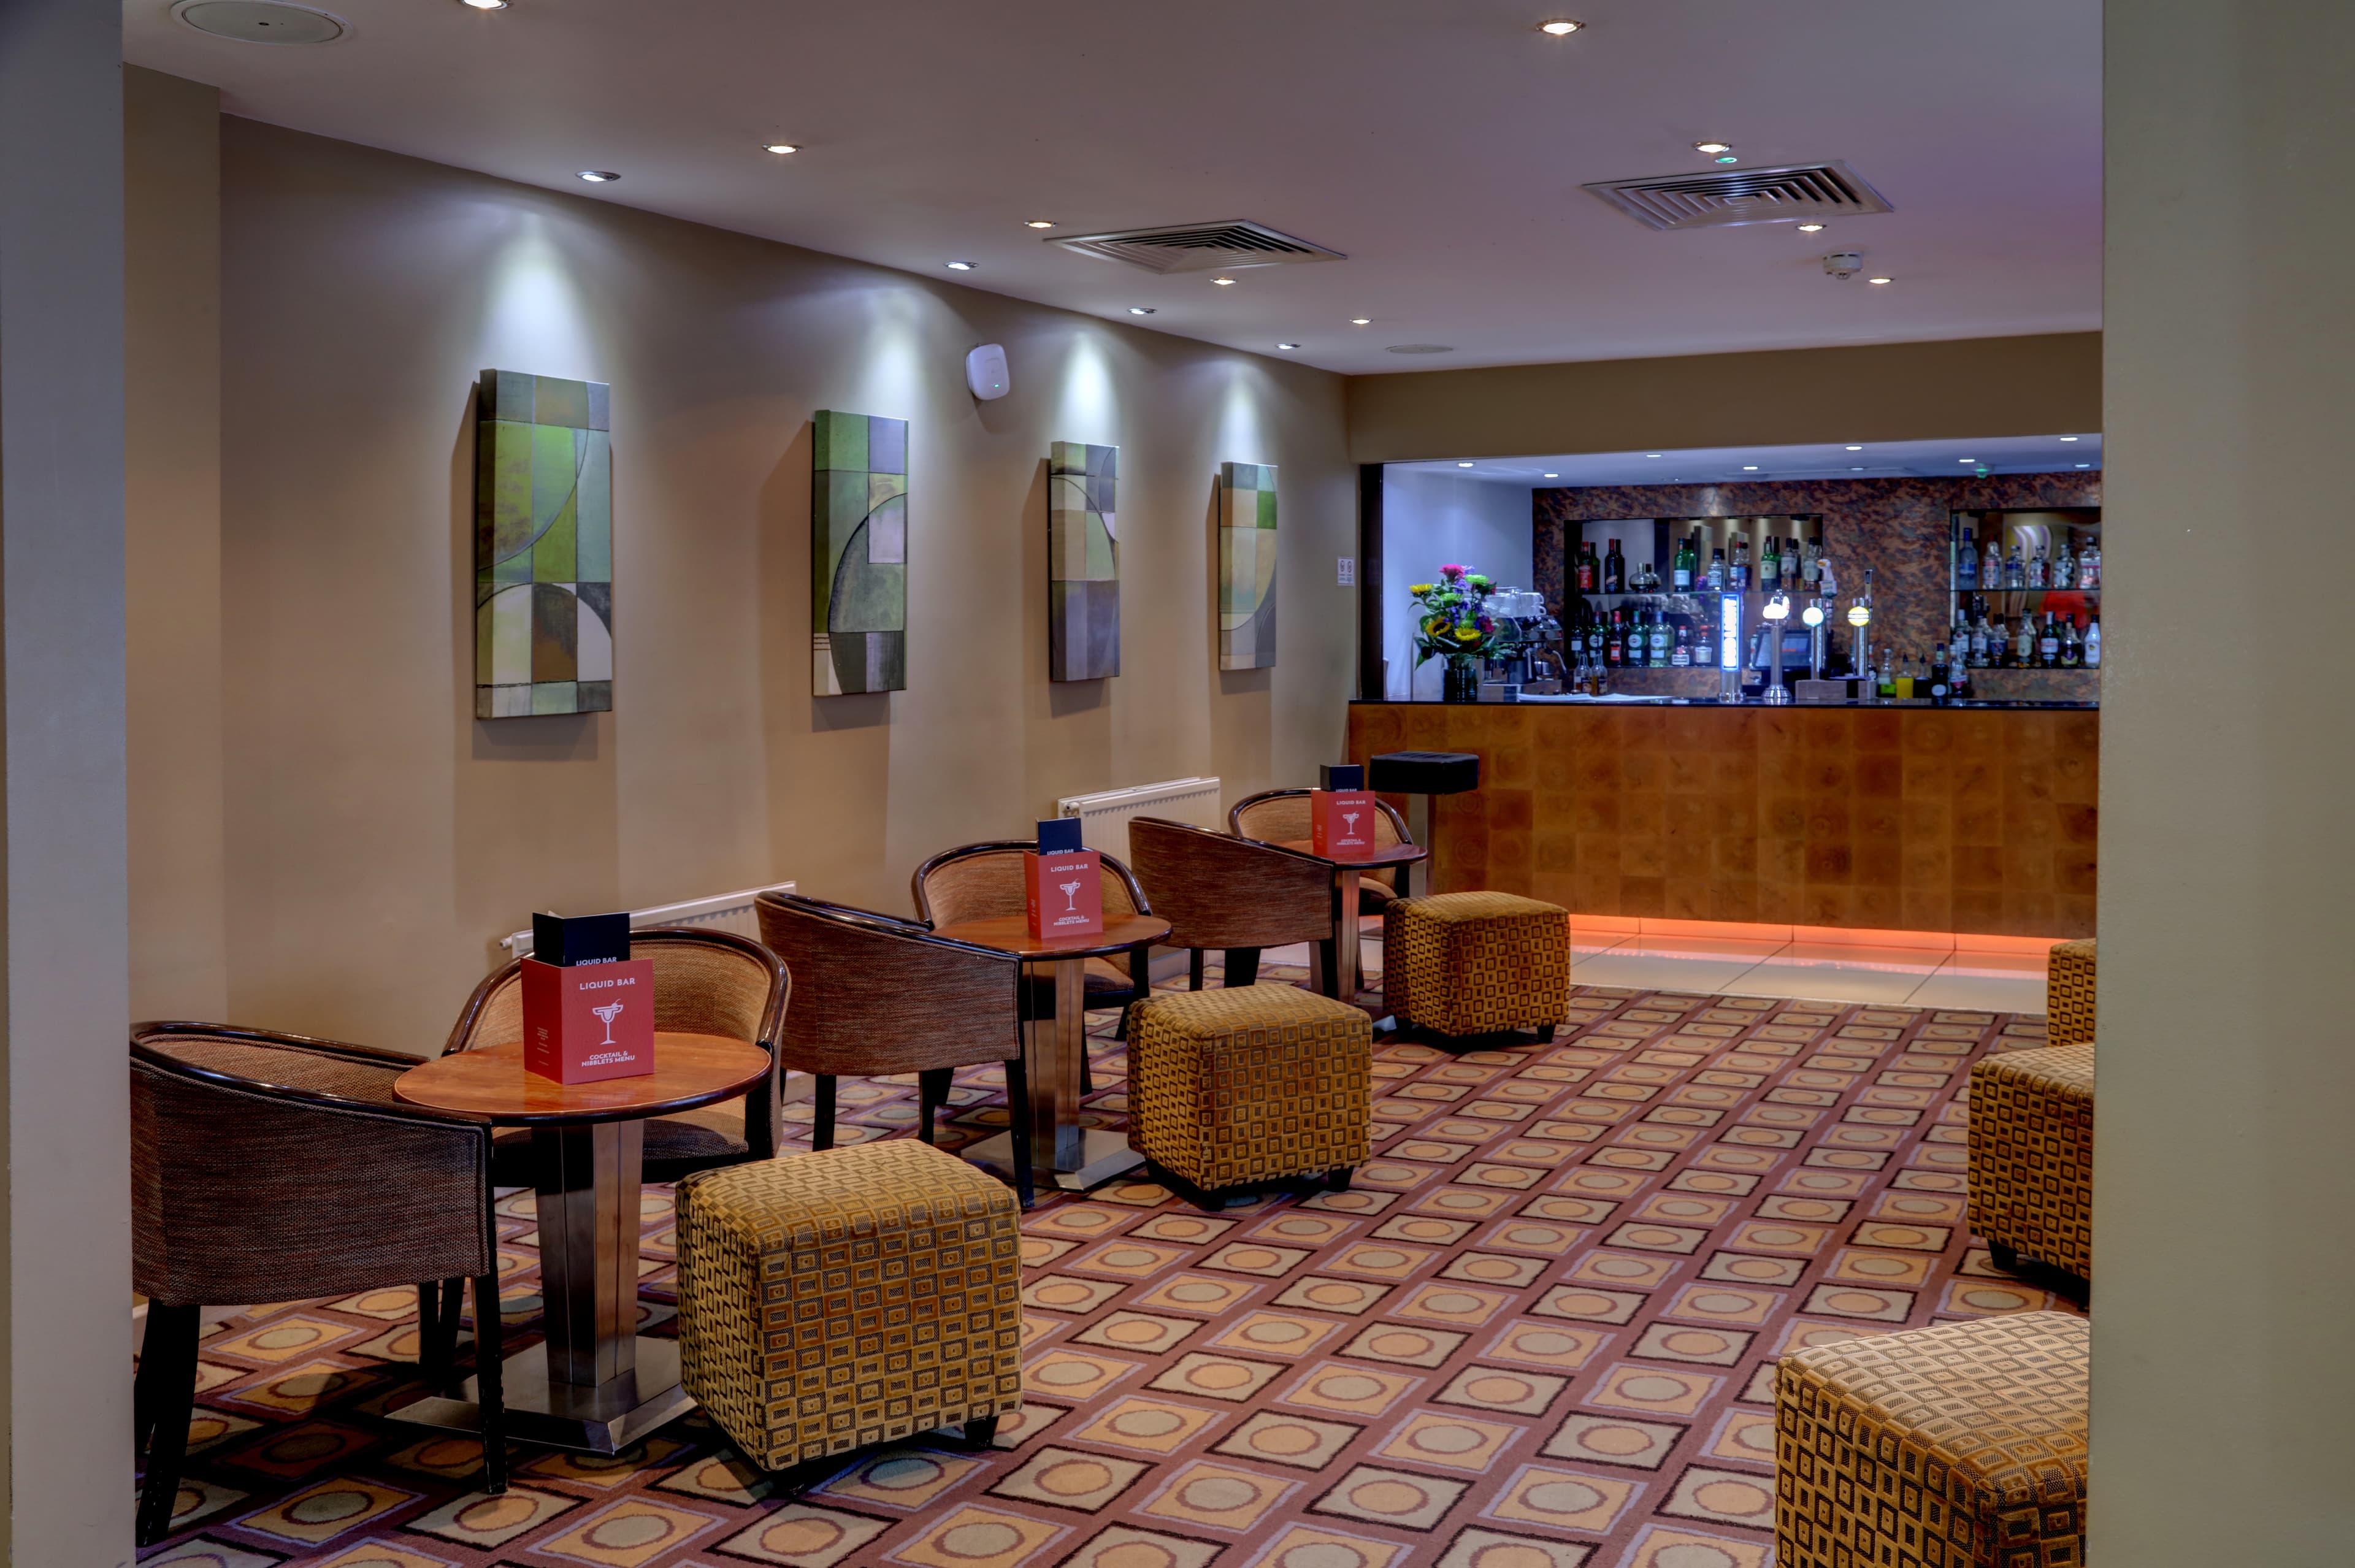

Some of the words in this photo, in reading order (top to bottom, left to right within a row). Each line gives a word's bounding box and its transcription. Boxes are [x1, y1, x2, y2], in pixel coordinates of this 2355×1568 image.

[580, 980, 614, 990] LIQUID
[617, 977, 635, 986] BAR
[589, 1052, 622, 1060] COCKTAIL
[581, 1058, 613, 1067] NIBBLETS
